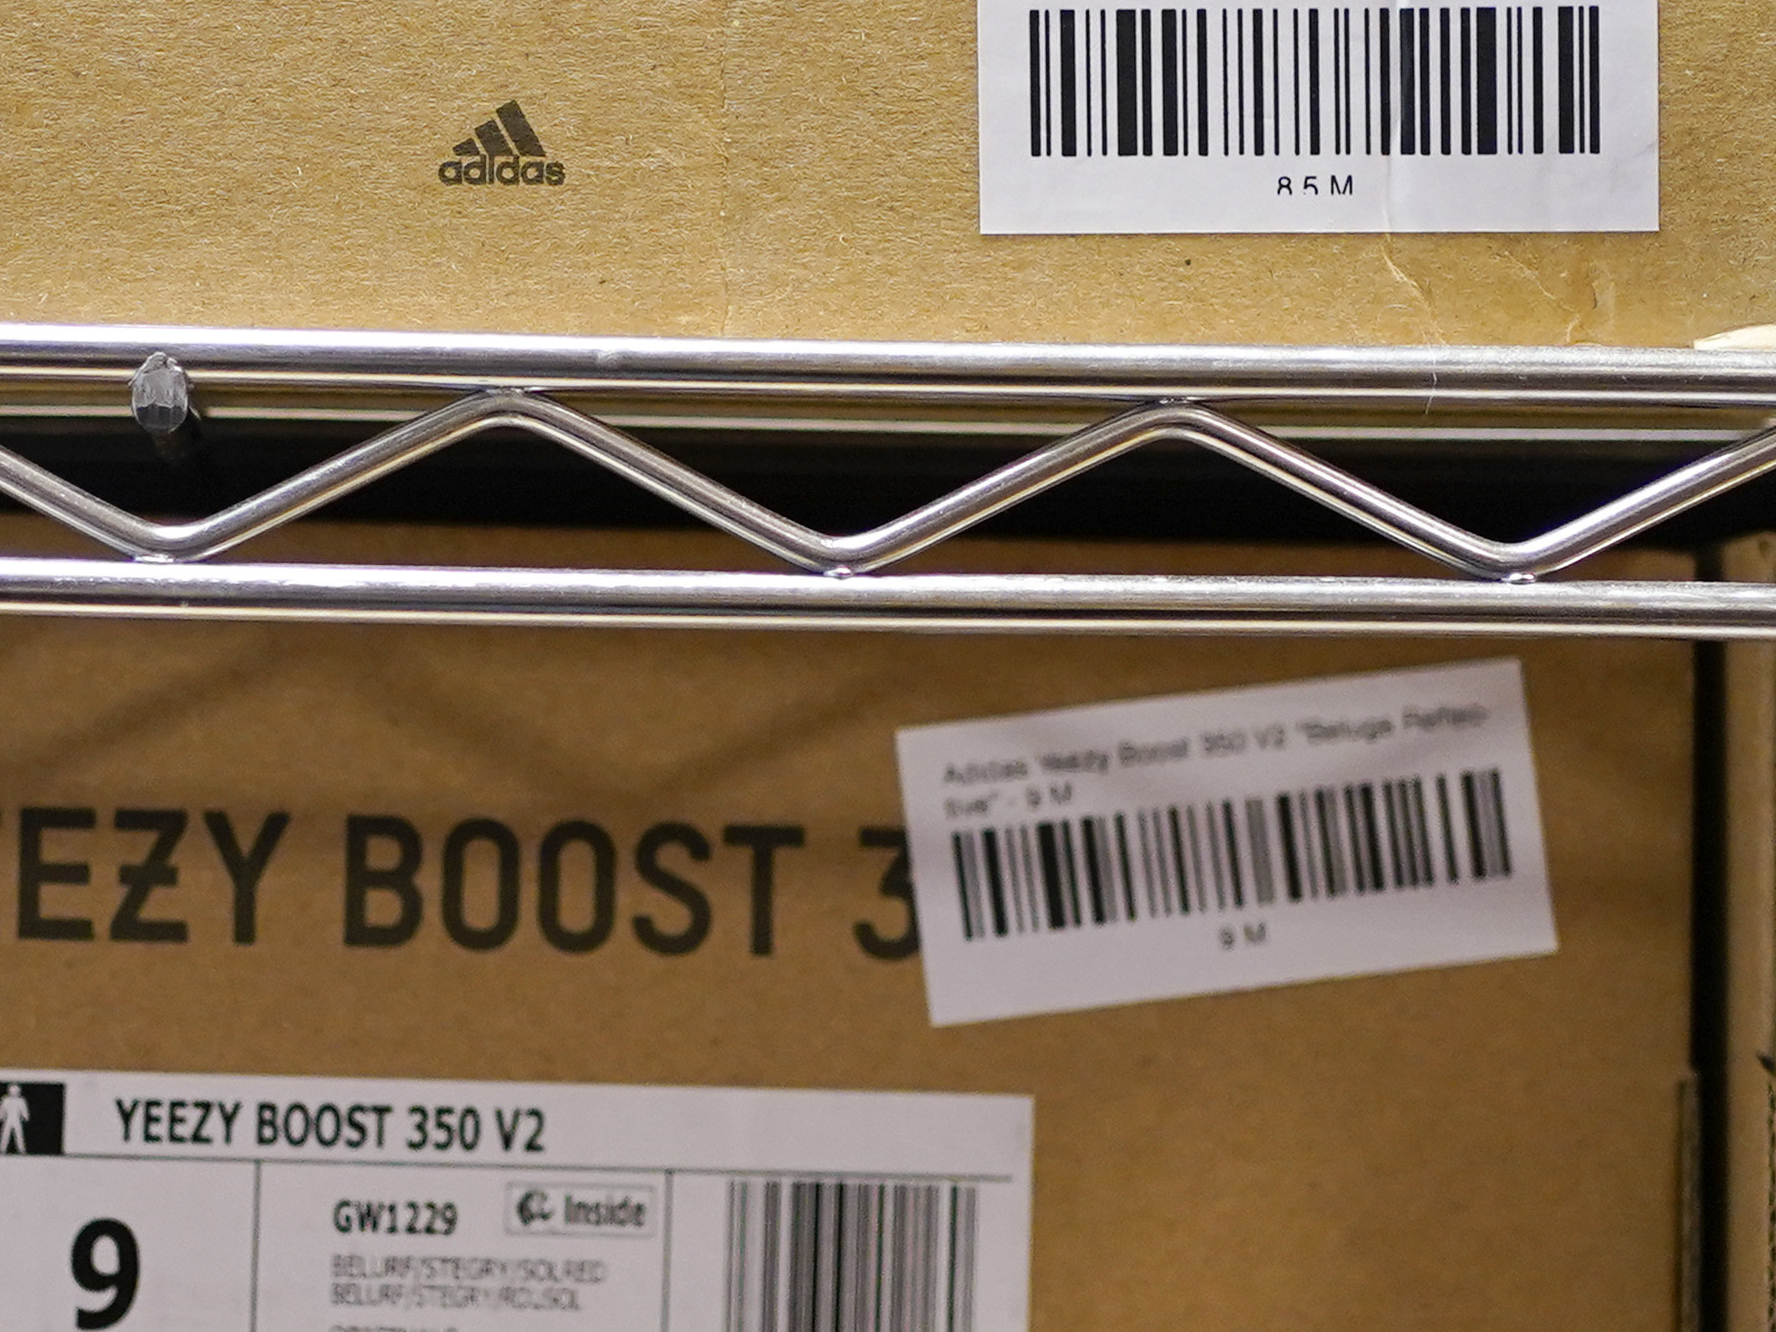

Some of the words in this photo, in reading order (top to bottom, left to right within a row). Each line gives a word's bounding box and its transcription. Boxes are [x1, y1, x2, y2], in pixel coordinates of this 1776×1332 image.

[438, 152, 565, 186] adidas
[1331, 175, 1352, 194] M
[344, 812, 808, 956] BOOST
[116, 1099, 240, 1144] YEEZY
[257, 1102, 393, 1148] BOOST
[407, 1106, 480, 1151] 350
[496, 1109, 544, 1152] V2
[334, 1200, 457, 1235] GW1229
[71, 1218, 140, 1331] 9
